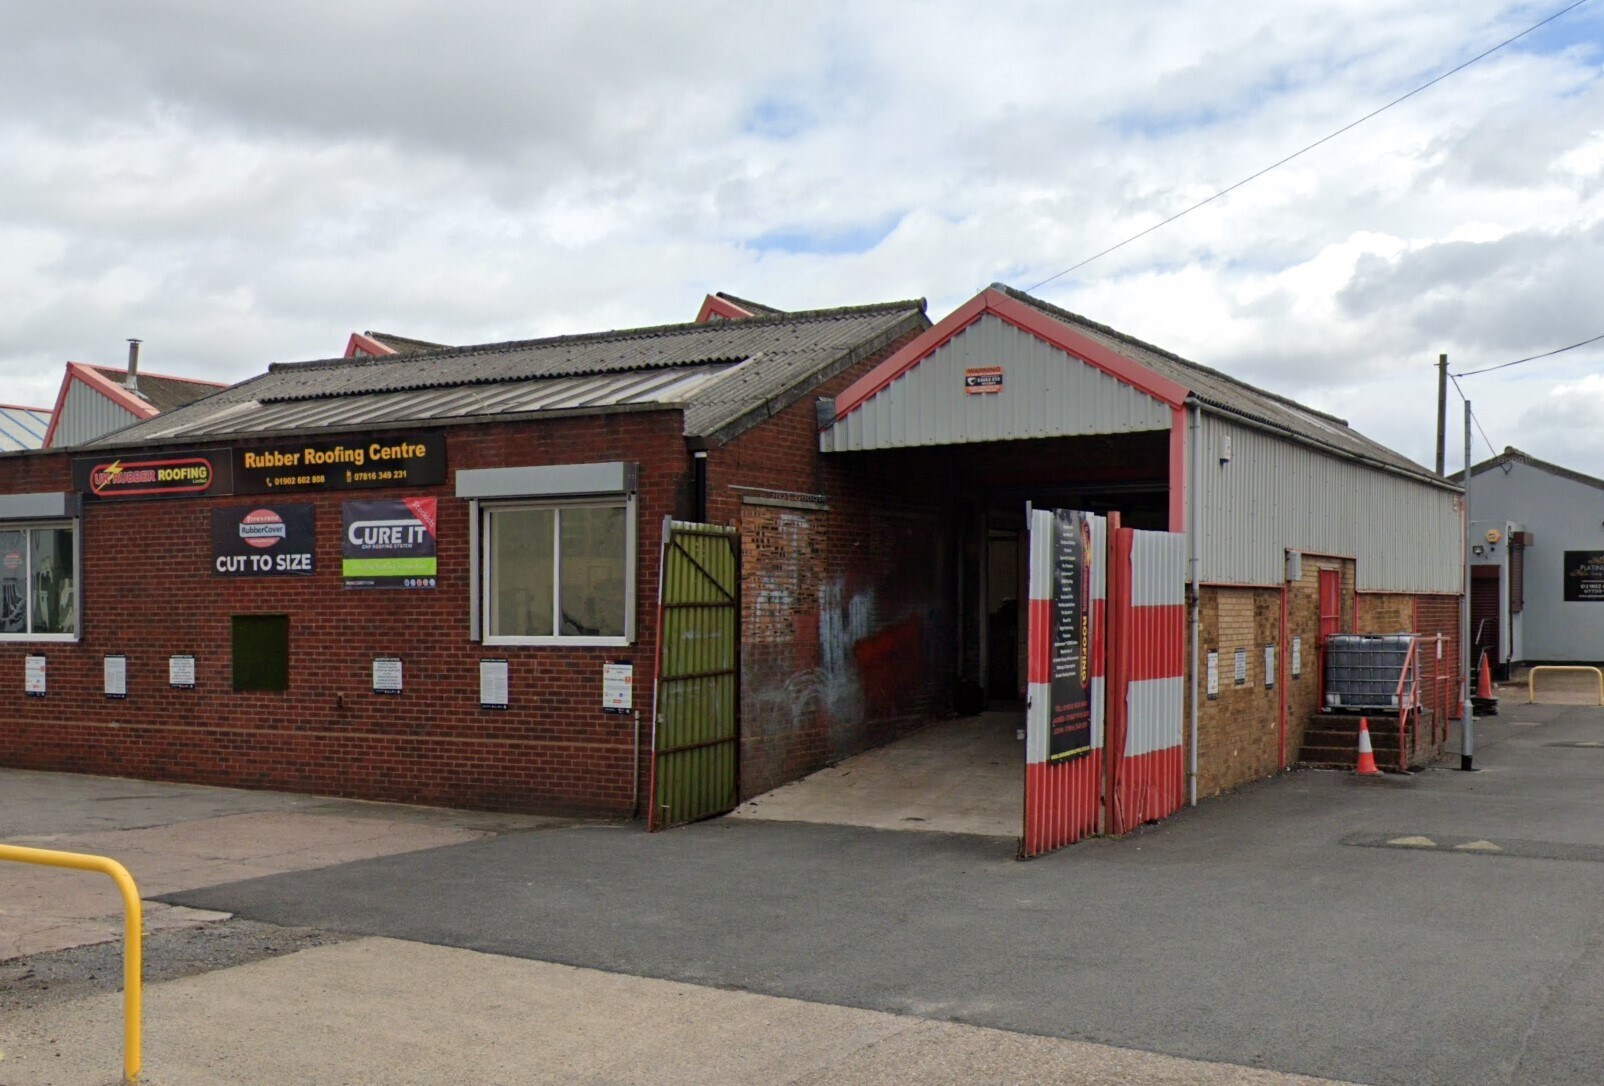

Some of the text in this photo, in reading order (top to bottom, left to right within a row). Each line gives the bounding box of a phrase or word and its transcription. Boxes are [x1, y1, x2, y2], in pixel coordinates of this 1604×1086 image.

[244, 443, 427, 468] Rubber Roofing Centre
[112, 470, 156, 484] RUBBER
[157, 467, 207, 481] ROOFING
[274, 477, 297, 486] 01902
[354, 470, 407, 481] 07816 349 231
[241, 526, 283, 534] RubberCover
[348, 520, 427, 545] CURE IT
[216, 554, 312, 573] CUT TO SIZE
